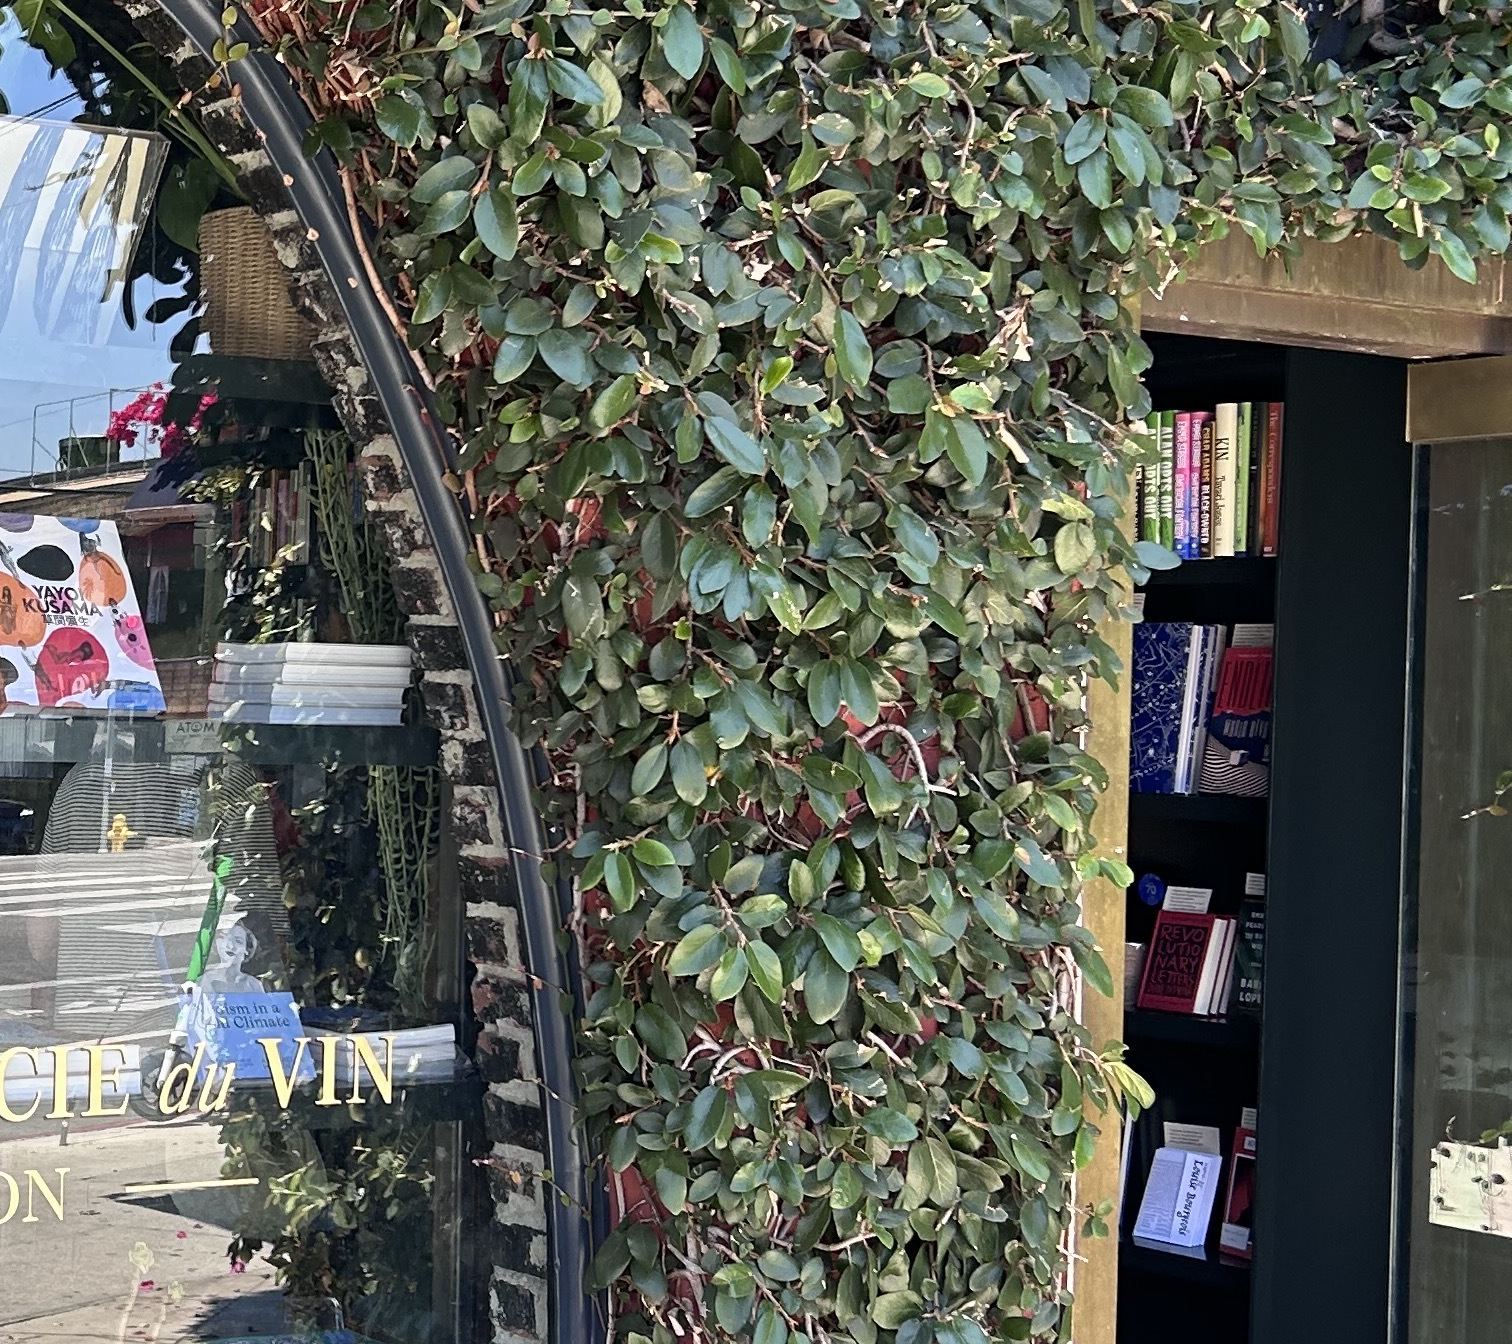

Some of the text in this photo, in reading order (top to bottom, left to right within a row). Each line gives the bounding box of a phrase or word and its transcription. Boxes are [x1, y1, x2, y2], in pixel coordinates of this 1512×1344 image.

[1215, 437, 1230, 460] KIN
[1144, 464, 1157, 493] PTS
[1159, 427, 1173, 519] ALAN OPTS OUT
[22, 597, 104, 617] KUSAMA
[1160, 924, 1205, 942] REVO
[1157, 941, 1201, 955] LUTIO
[252, 1001, 269, 1015] in
[271, 1004, 281, 1014] a
[233, 1015, 291, 1029] Climate
[158, 1040, 236, 1115] du
[256, 1034, 398, 1109] VIN
